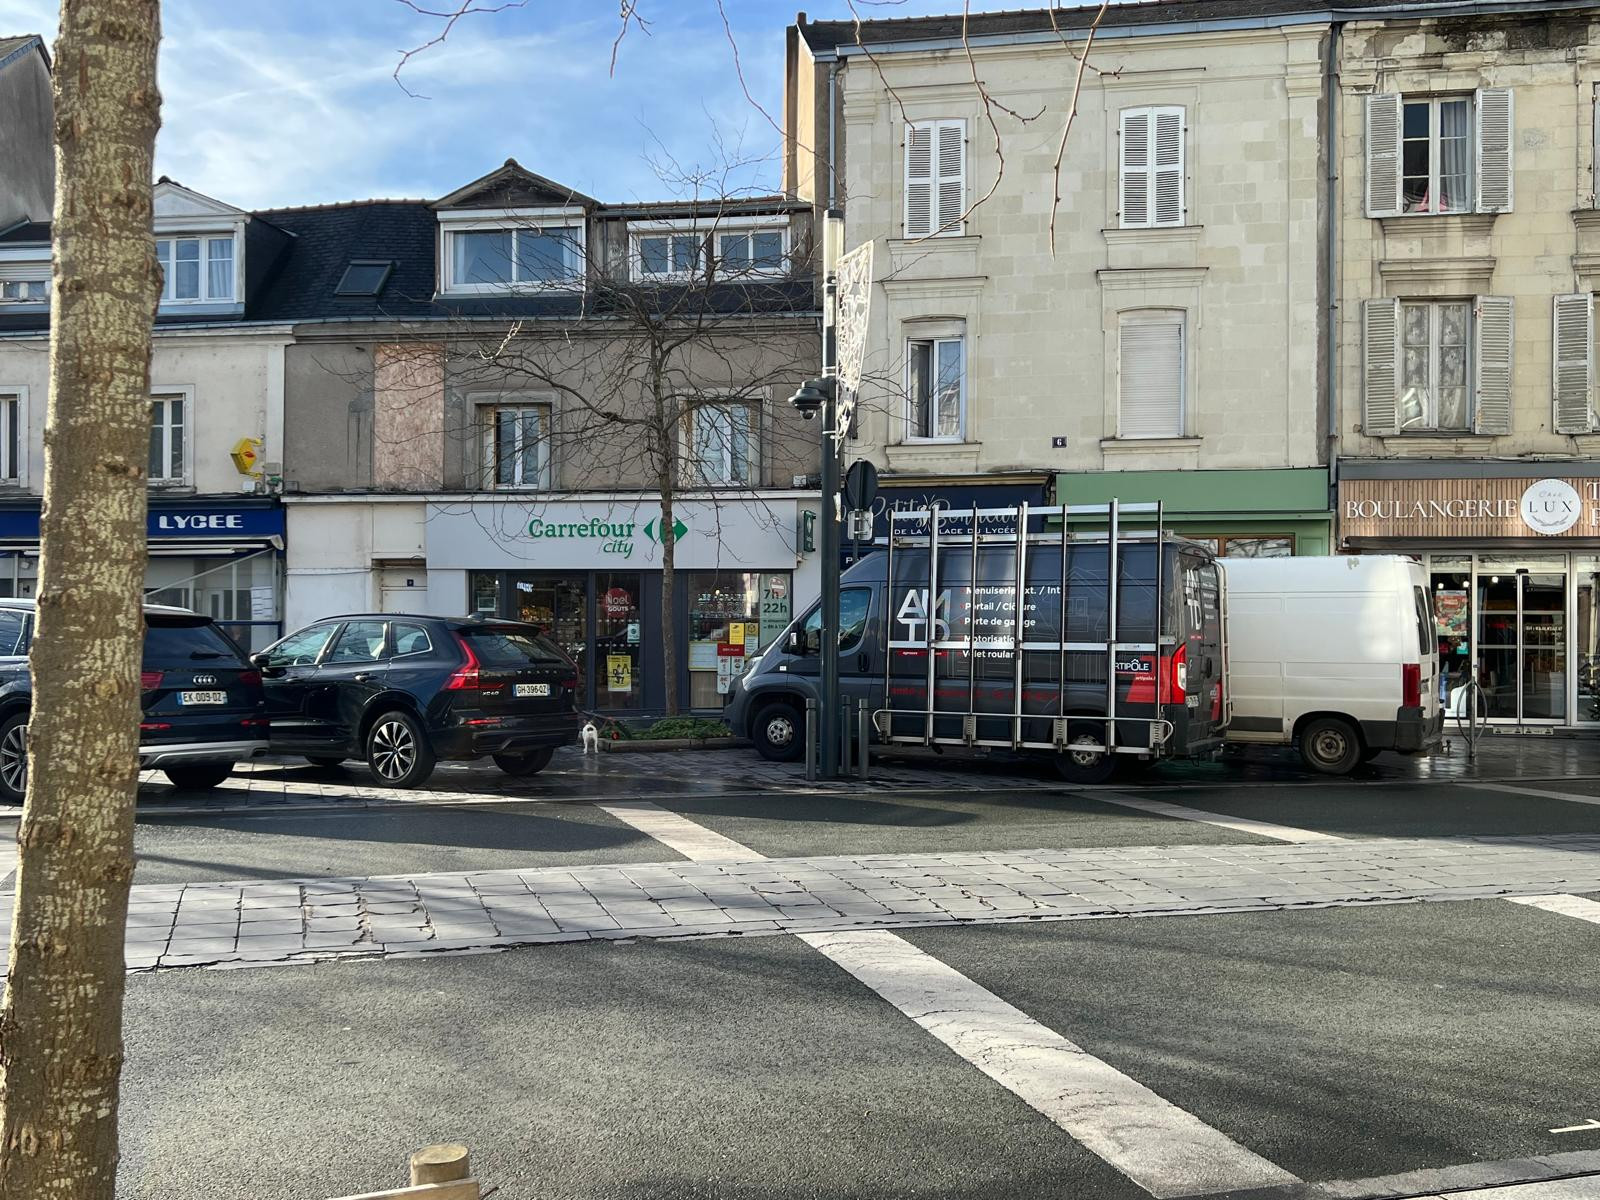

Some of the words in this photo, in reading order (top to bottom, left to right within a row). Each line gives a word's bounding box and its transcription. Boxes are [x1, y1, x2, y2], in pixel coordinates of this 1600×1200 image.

[1345, 499, 1517, 519] BOULANGERIE
[1529, 500, 1573, 513] LUX
[159, 514, 244, 529] LYCEE
[528, 517, 636, 538] Carrefour
[938, 527, 963, 535] LACE
[985, 525, 1017, 535] LYCÉE
[603, 540, 634, 559] city
[762, 603, 788, 614] 22h
[964, 602, 994, 611] Prtail
[964, 617, 989, 626] Prte
[990, 617, 1002, 626] de
[1114, 659, 1150, 671] RTIPÔLE
